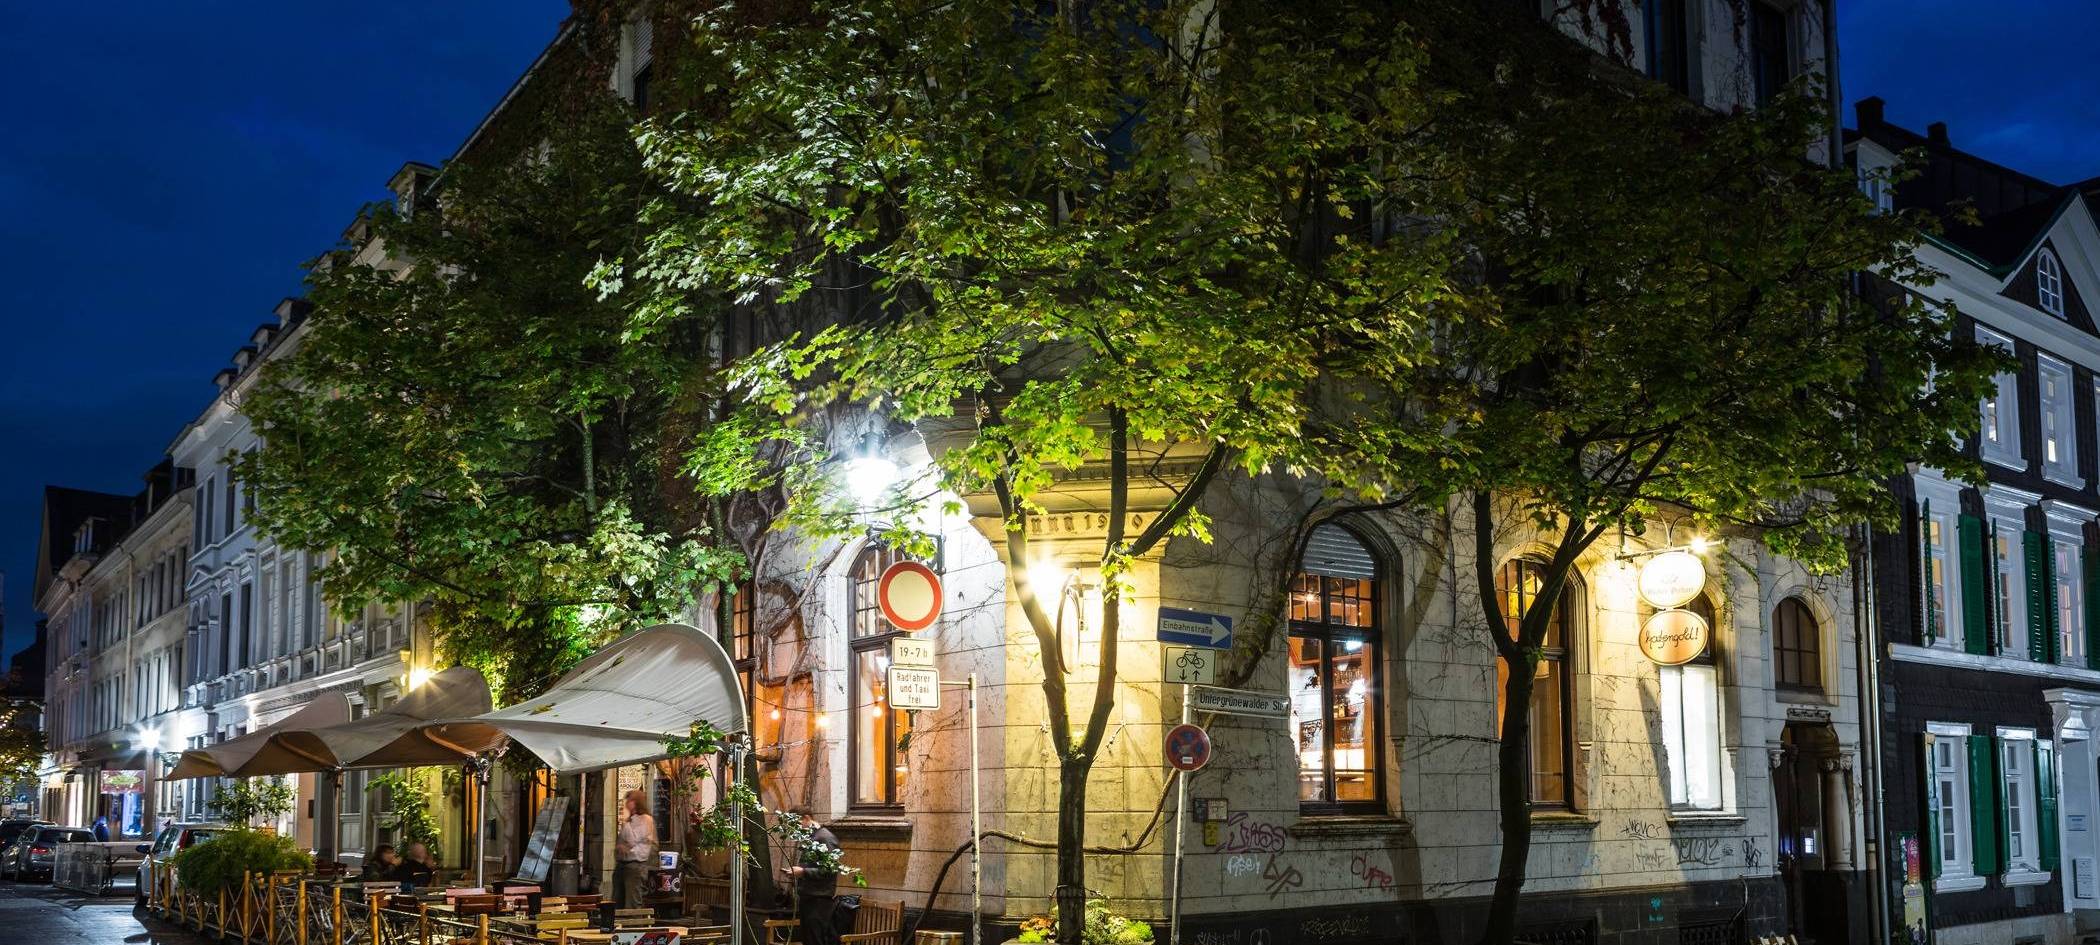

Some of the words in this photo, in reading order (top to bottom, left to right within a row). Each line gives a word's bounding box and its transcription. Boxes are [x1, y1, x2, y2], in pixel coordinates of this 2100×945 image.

[1084, 514, 1143, 530] 190
[1162, 620, 1213, 633] Einbahnstraße
[896, 672, 930, 683] Radfahrer
[899, 684, 912, 693] und
[914, 684, 929, 693] Taxi
[908, 695, 921, 704] frei
[1199, 693, 1269, 710] Untergrünewalder
